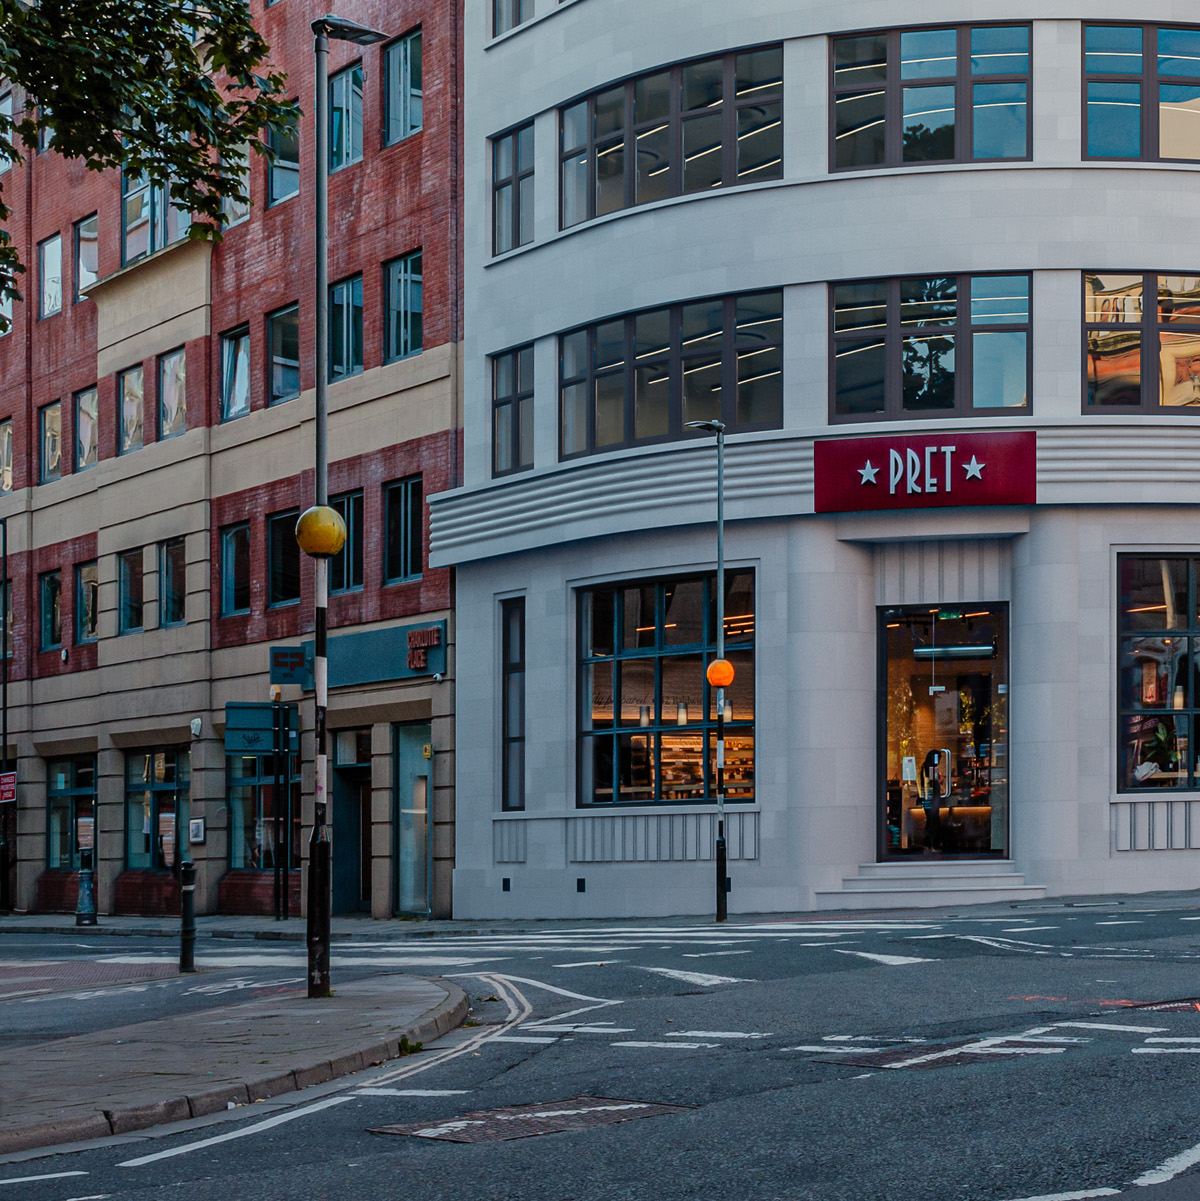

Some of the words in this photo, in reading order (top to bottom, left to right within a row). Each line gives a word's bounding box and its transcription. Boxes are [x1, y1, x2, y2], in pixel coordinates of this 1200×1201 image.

[889, 445, 957, 495] PRET
[407, 626, 441, 649] CHARLOTTE
[407, 648, 427, 669] PLACE
